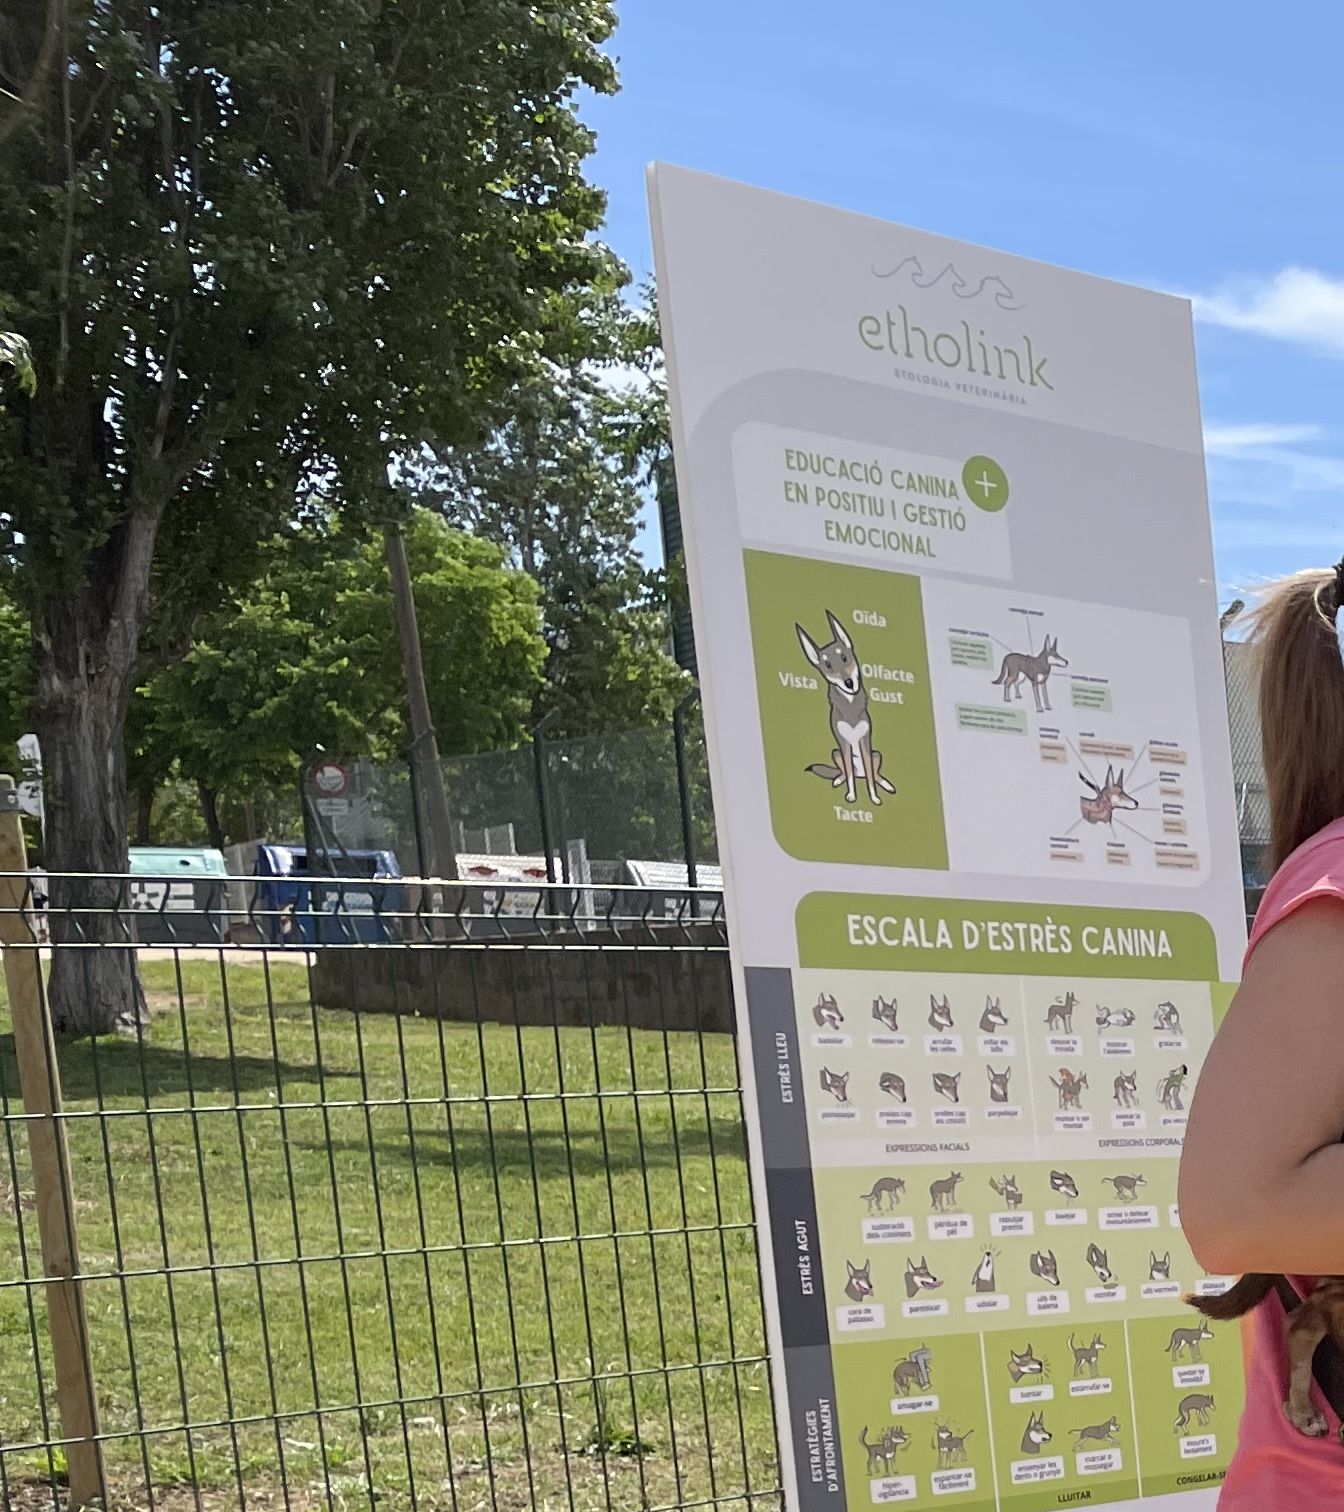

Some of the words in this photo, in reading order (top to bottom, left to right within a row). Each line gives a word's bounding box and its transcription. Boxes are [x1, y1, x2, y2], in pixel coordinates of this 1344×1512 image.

[857, 303, 1055, 391] etholink
[893, 367, 950, 390] ETOLOGIA
[784, 447, 883, 486] EDUCACIÓ
[890, 469, 960, 501] CANINA
[783, 480, 809, 505] EN
[815, 486, 885, 518] POSITIU
[891, 499, 897, 521] I
[903, 502, 967, 532] GESTIÓ
[824, 519, 937, 558] EMOCIONAL
[852, 609, 887, 628] Oïda
[778, 671, 819, 690] Vista
[861, 662, 915, 684] Olfacte
[869, 687, 904, 705] Gust
[833, 804, 874, 824] Tacte
[847, 913, 953, 949] ESCALA
[961, 915, 1073, 953] D'ESTRÈS
[1081, 926, 1173, 959] CANINA
[775, 1032, 789, 1060] LLEU
[776, 1063, 793, 1103] ESTRÈS
[885, 1143, 938, 1153] EXPRESSIONS
[939, 1142, 970, 1152] FACIALS
[1098, 1138, 1144, 1148] EXPRESSIONS
[795, 1219, 808, 1252] AGUT
[797, 1255, 813, 1295] ESTRÈS
[805, 1410, 823, 1482] ESTRATÈGIES
[819, 1398, 839, 1493] D'AFRONTAMENT
[1057, 1490, 1092, 1502] LLUITAR
